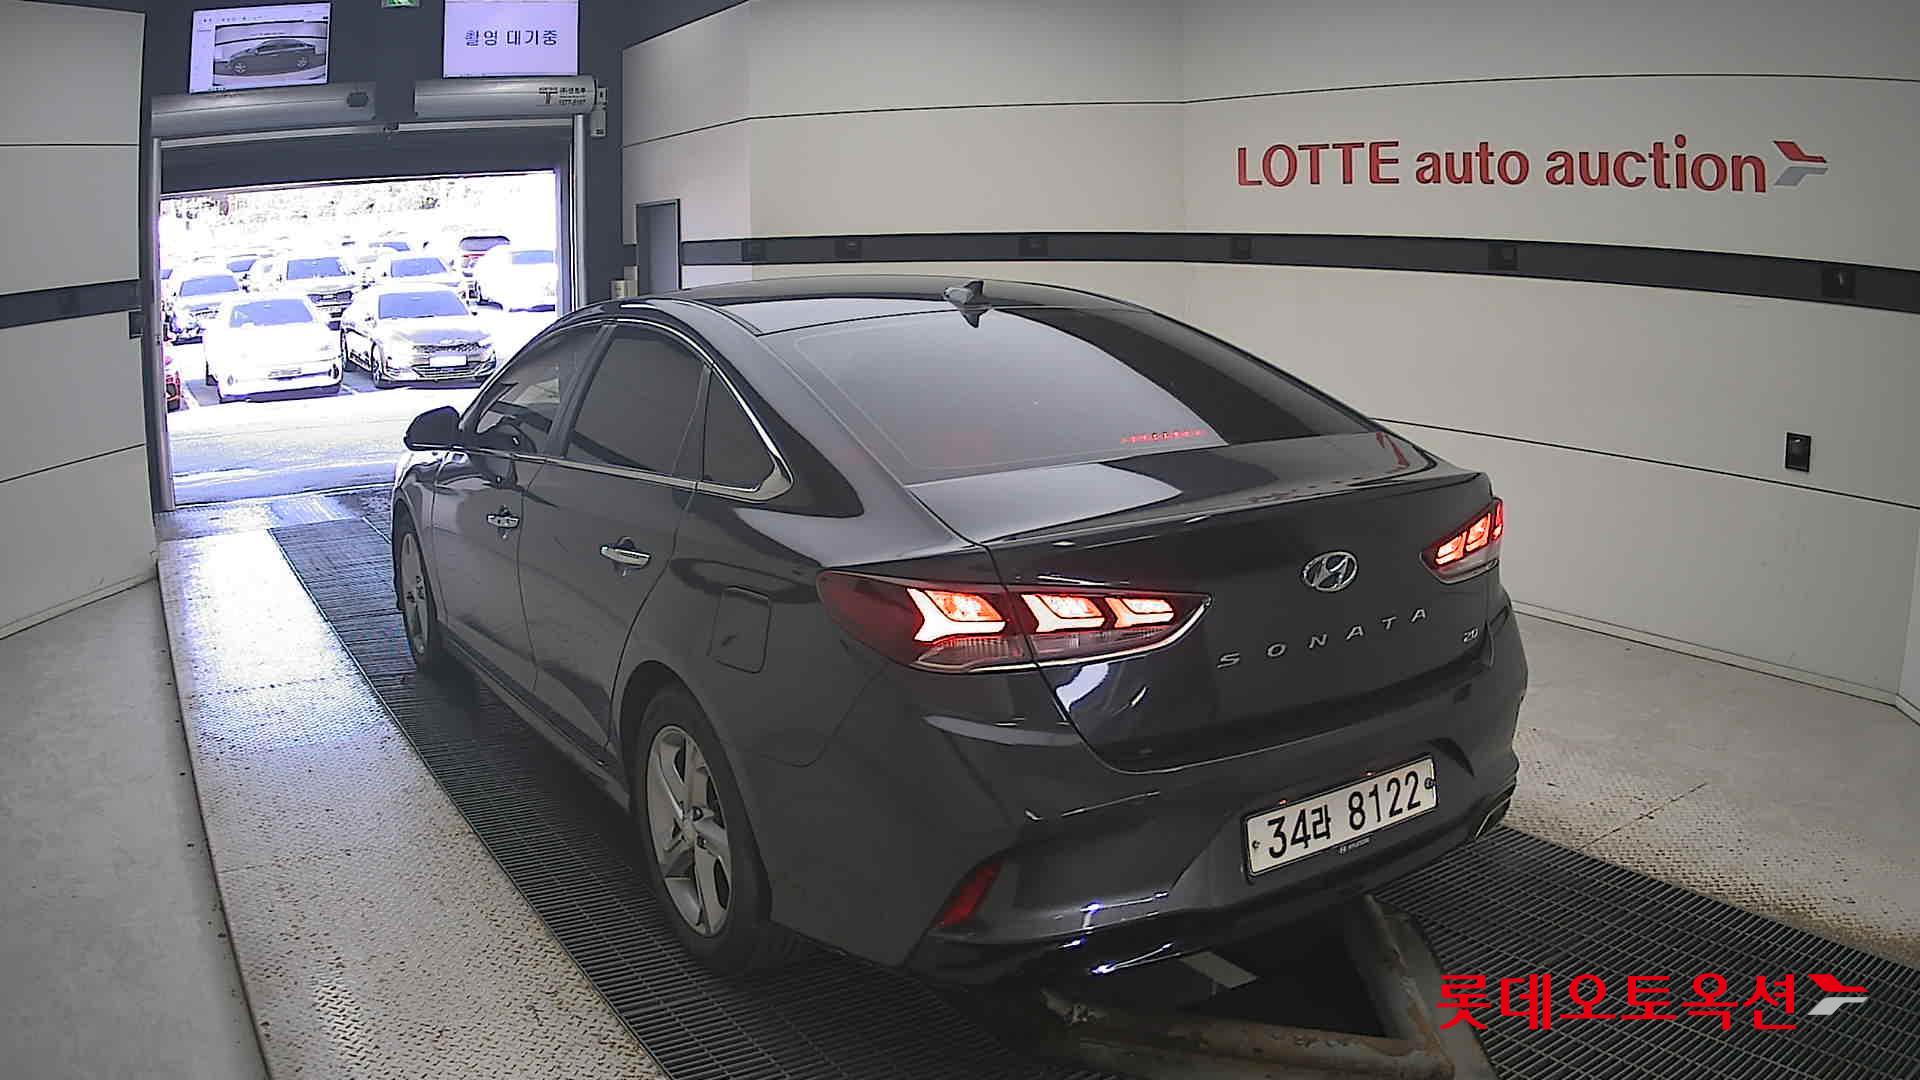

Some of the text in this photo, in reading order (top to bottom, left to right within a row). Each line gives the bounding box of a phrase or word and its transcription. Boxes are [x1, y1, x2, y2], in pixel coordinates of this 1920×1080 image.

[506, 29, 558, 46] 대기중
[1237, 135, 1767, 193] LOTTE auto auction
[1217, 608, 1426, 669] SONATA
[1267, 771, 1421, 859] 34라 8122
